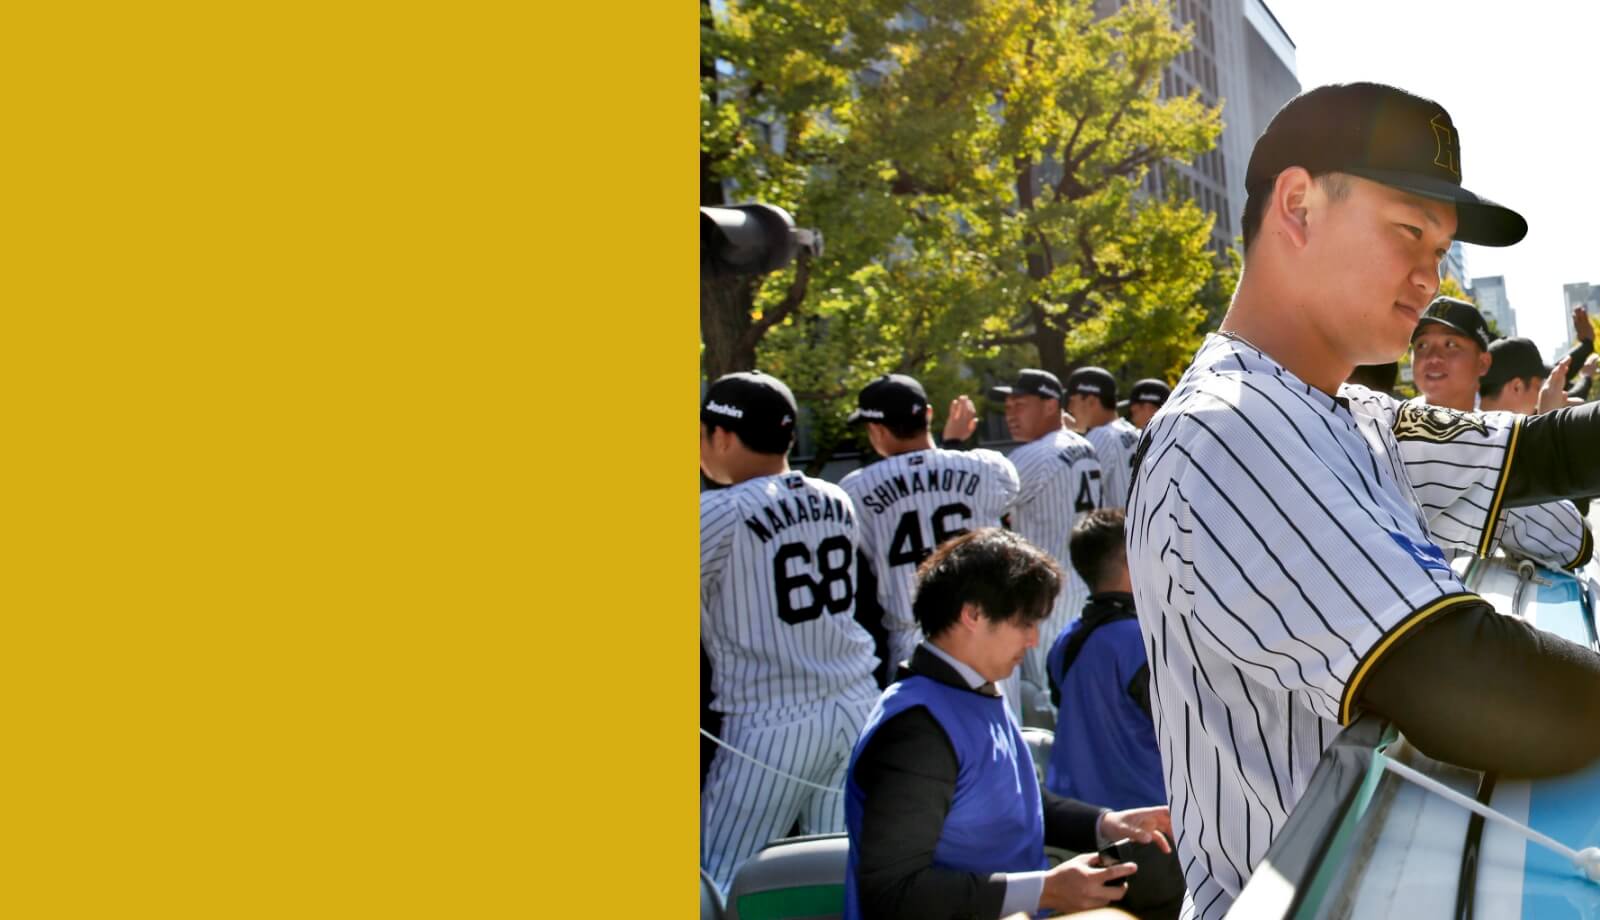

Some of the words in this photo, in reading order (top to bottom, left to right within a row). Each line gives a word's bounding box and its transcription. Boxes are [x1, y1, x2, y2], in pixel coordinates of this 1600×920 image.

[706, 399, 744, 419] Joshin
[863, 469, 981, 515] SHIMAMOTO
[888, 502, 973, 569] 46
[773, 534, 854, 626] 68
